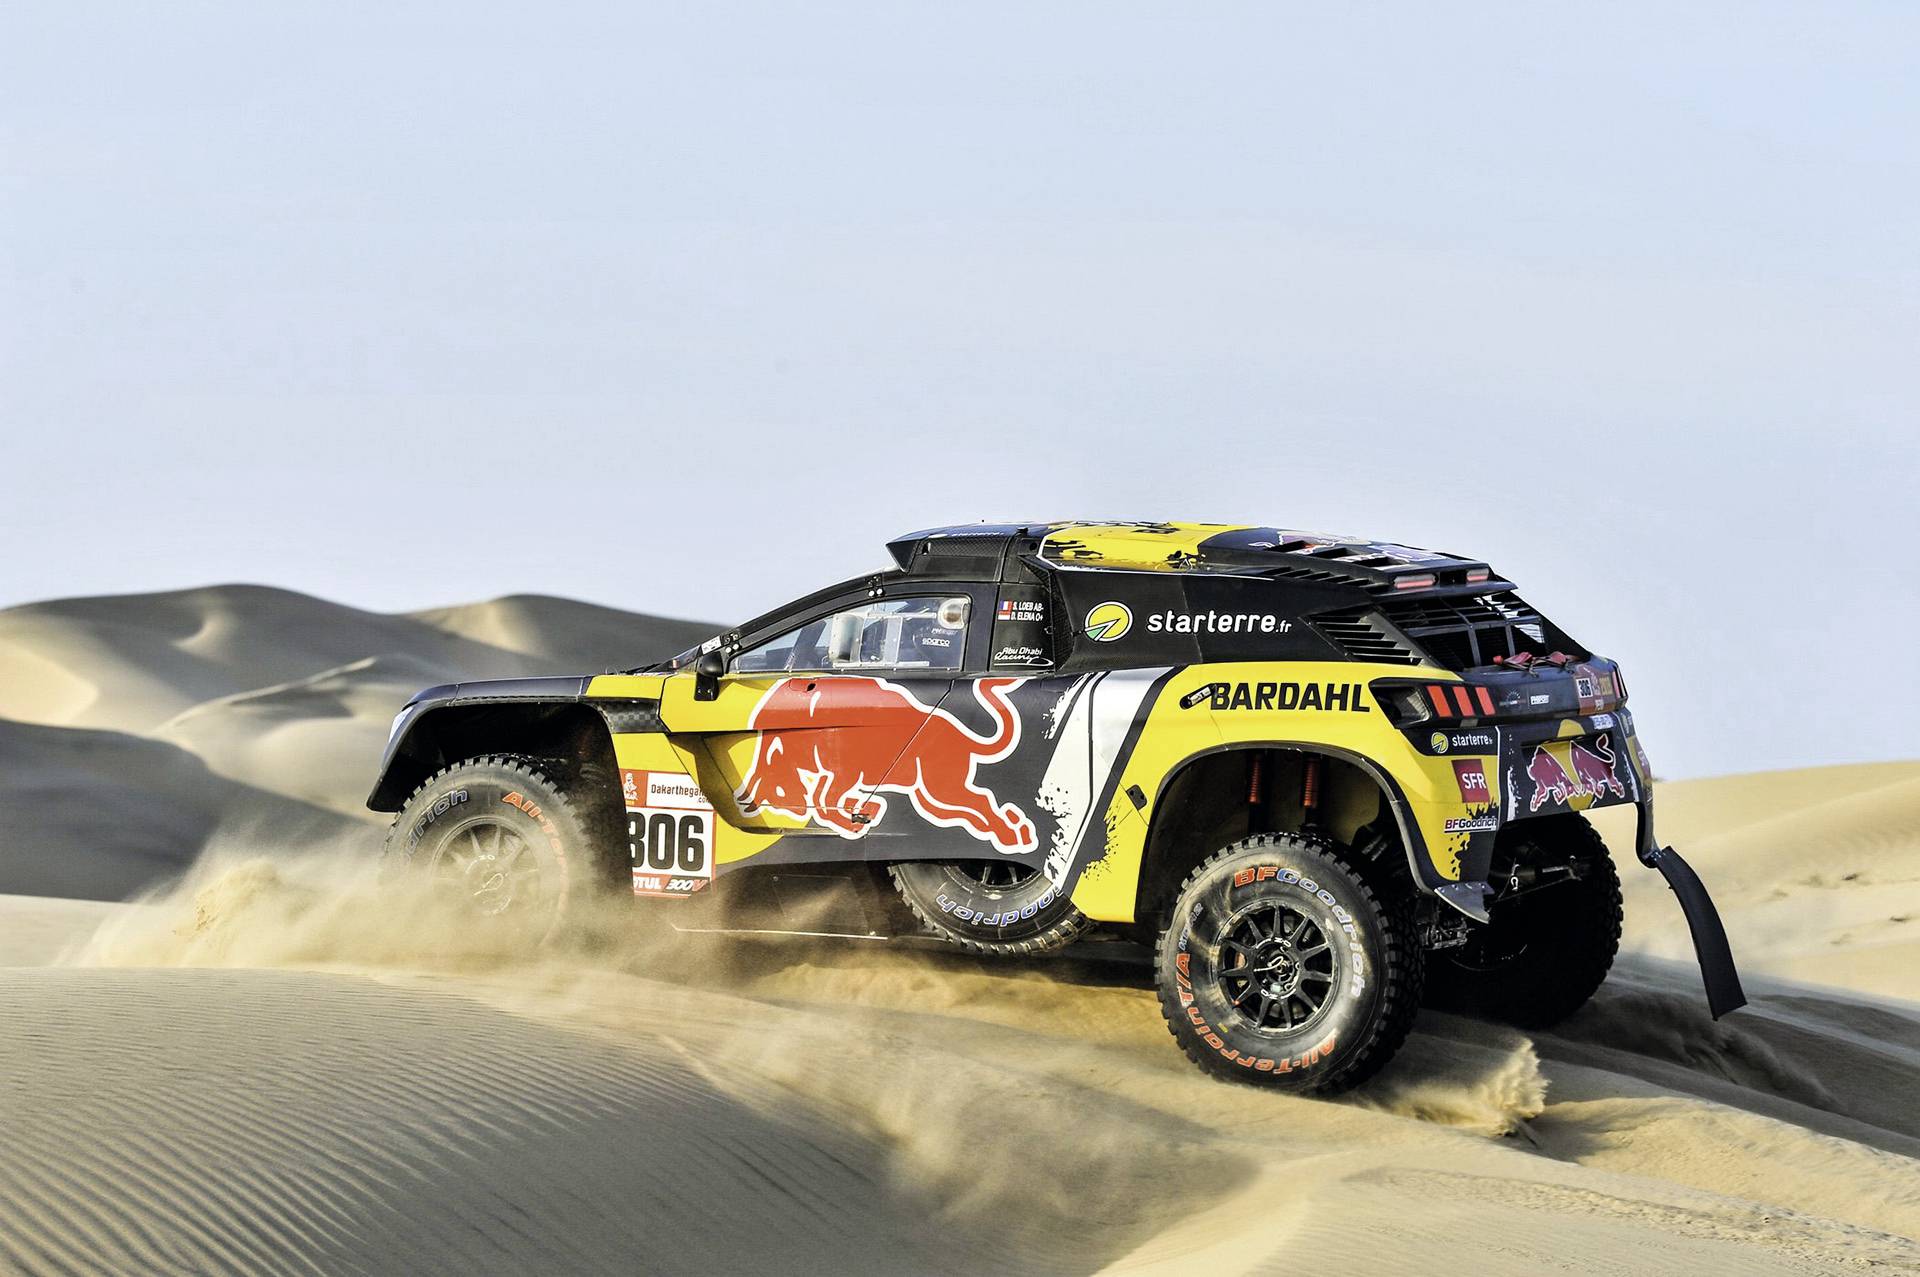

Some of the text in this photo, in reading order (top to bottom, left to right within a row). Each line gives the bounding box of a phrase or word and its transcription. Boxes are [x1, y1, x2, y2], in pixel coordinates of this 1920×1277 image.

[1018, 601, 1034, 611] LOEB
[1017, 612, 1035, 621] ELENA
[1147, 610, 1292, 633] starterre.fr
[1019, 647, 1042, 655] Dhabi
[1210, 682, 1371, 713] BARDAHL
[1462, 773, 1487, 789] SFR
[1445, 816, 1497, 830] BFGoodrich
[1234, 866, 1366, 997] BFGoodrich
[1187, 1006, 1338, 1075] All-Terrain
